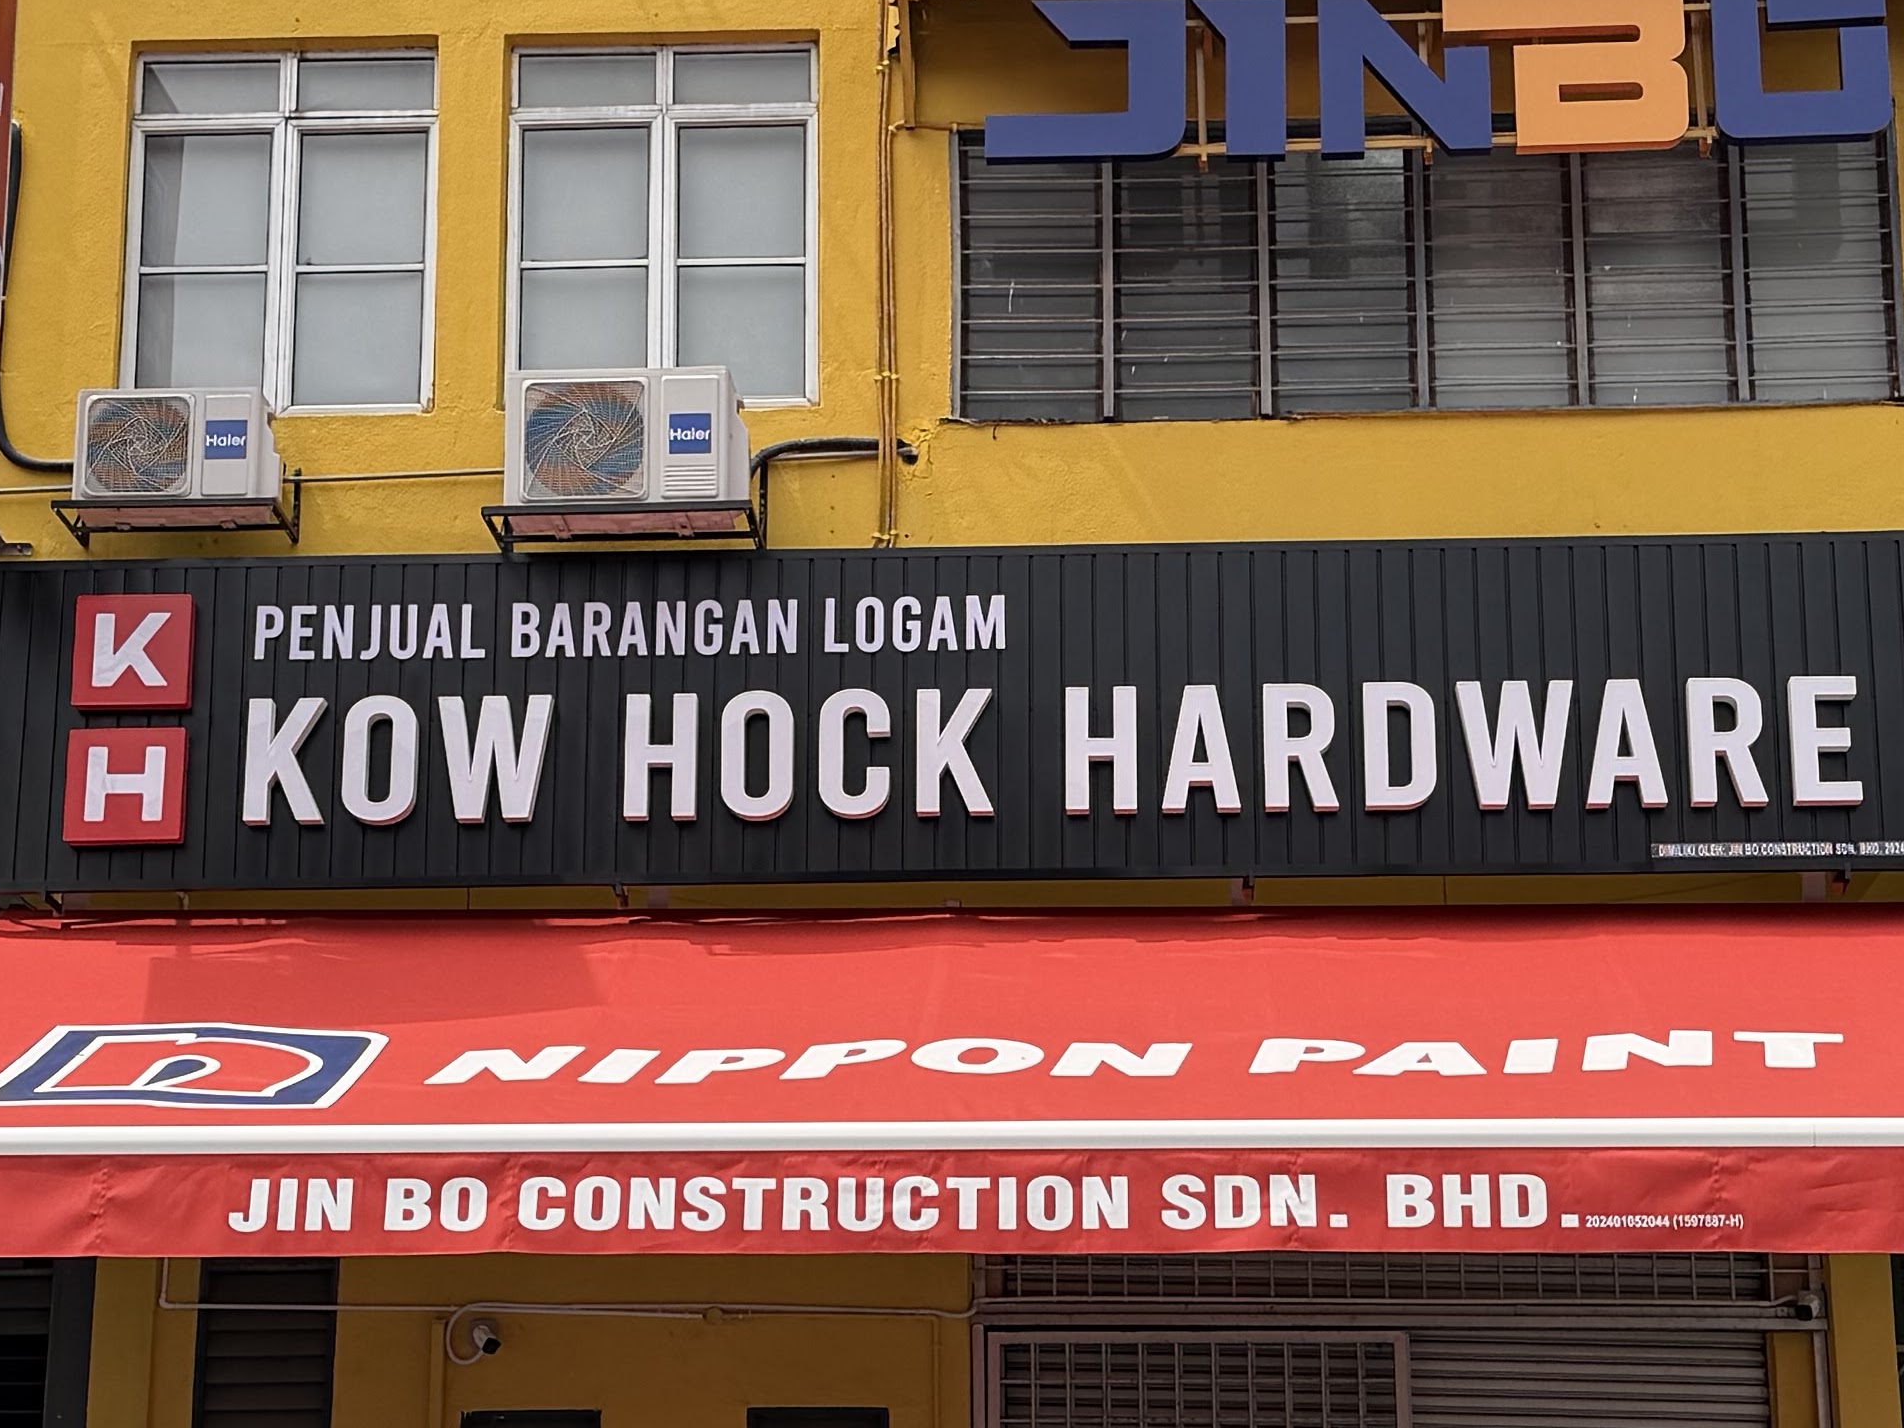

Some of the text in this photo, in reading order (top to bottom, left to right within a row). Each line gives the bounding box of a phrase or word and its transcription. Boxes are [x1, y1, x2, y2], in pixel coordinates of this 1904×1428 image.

[205, 433, 247, 449] Haier
[668, 426, 711, 443] Haier
[90, 610, 172, 688] K
[254, 593, 1007, 661] PENJUAL BARANGAN LOGAM
[241, 674, 1866, 827] KOW HOCK HARDWARE
[82, 744, 167, 824] H
[1760, 842, 1834, 857] CONSTRUCTION
[424, 1028, 1845, 1086] NIPPON PAINT
[228, 1172, 1745, 1234] JIN BO CONSTRUCTION SDN. BHD. 202401052044 (1597887-H)
